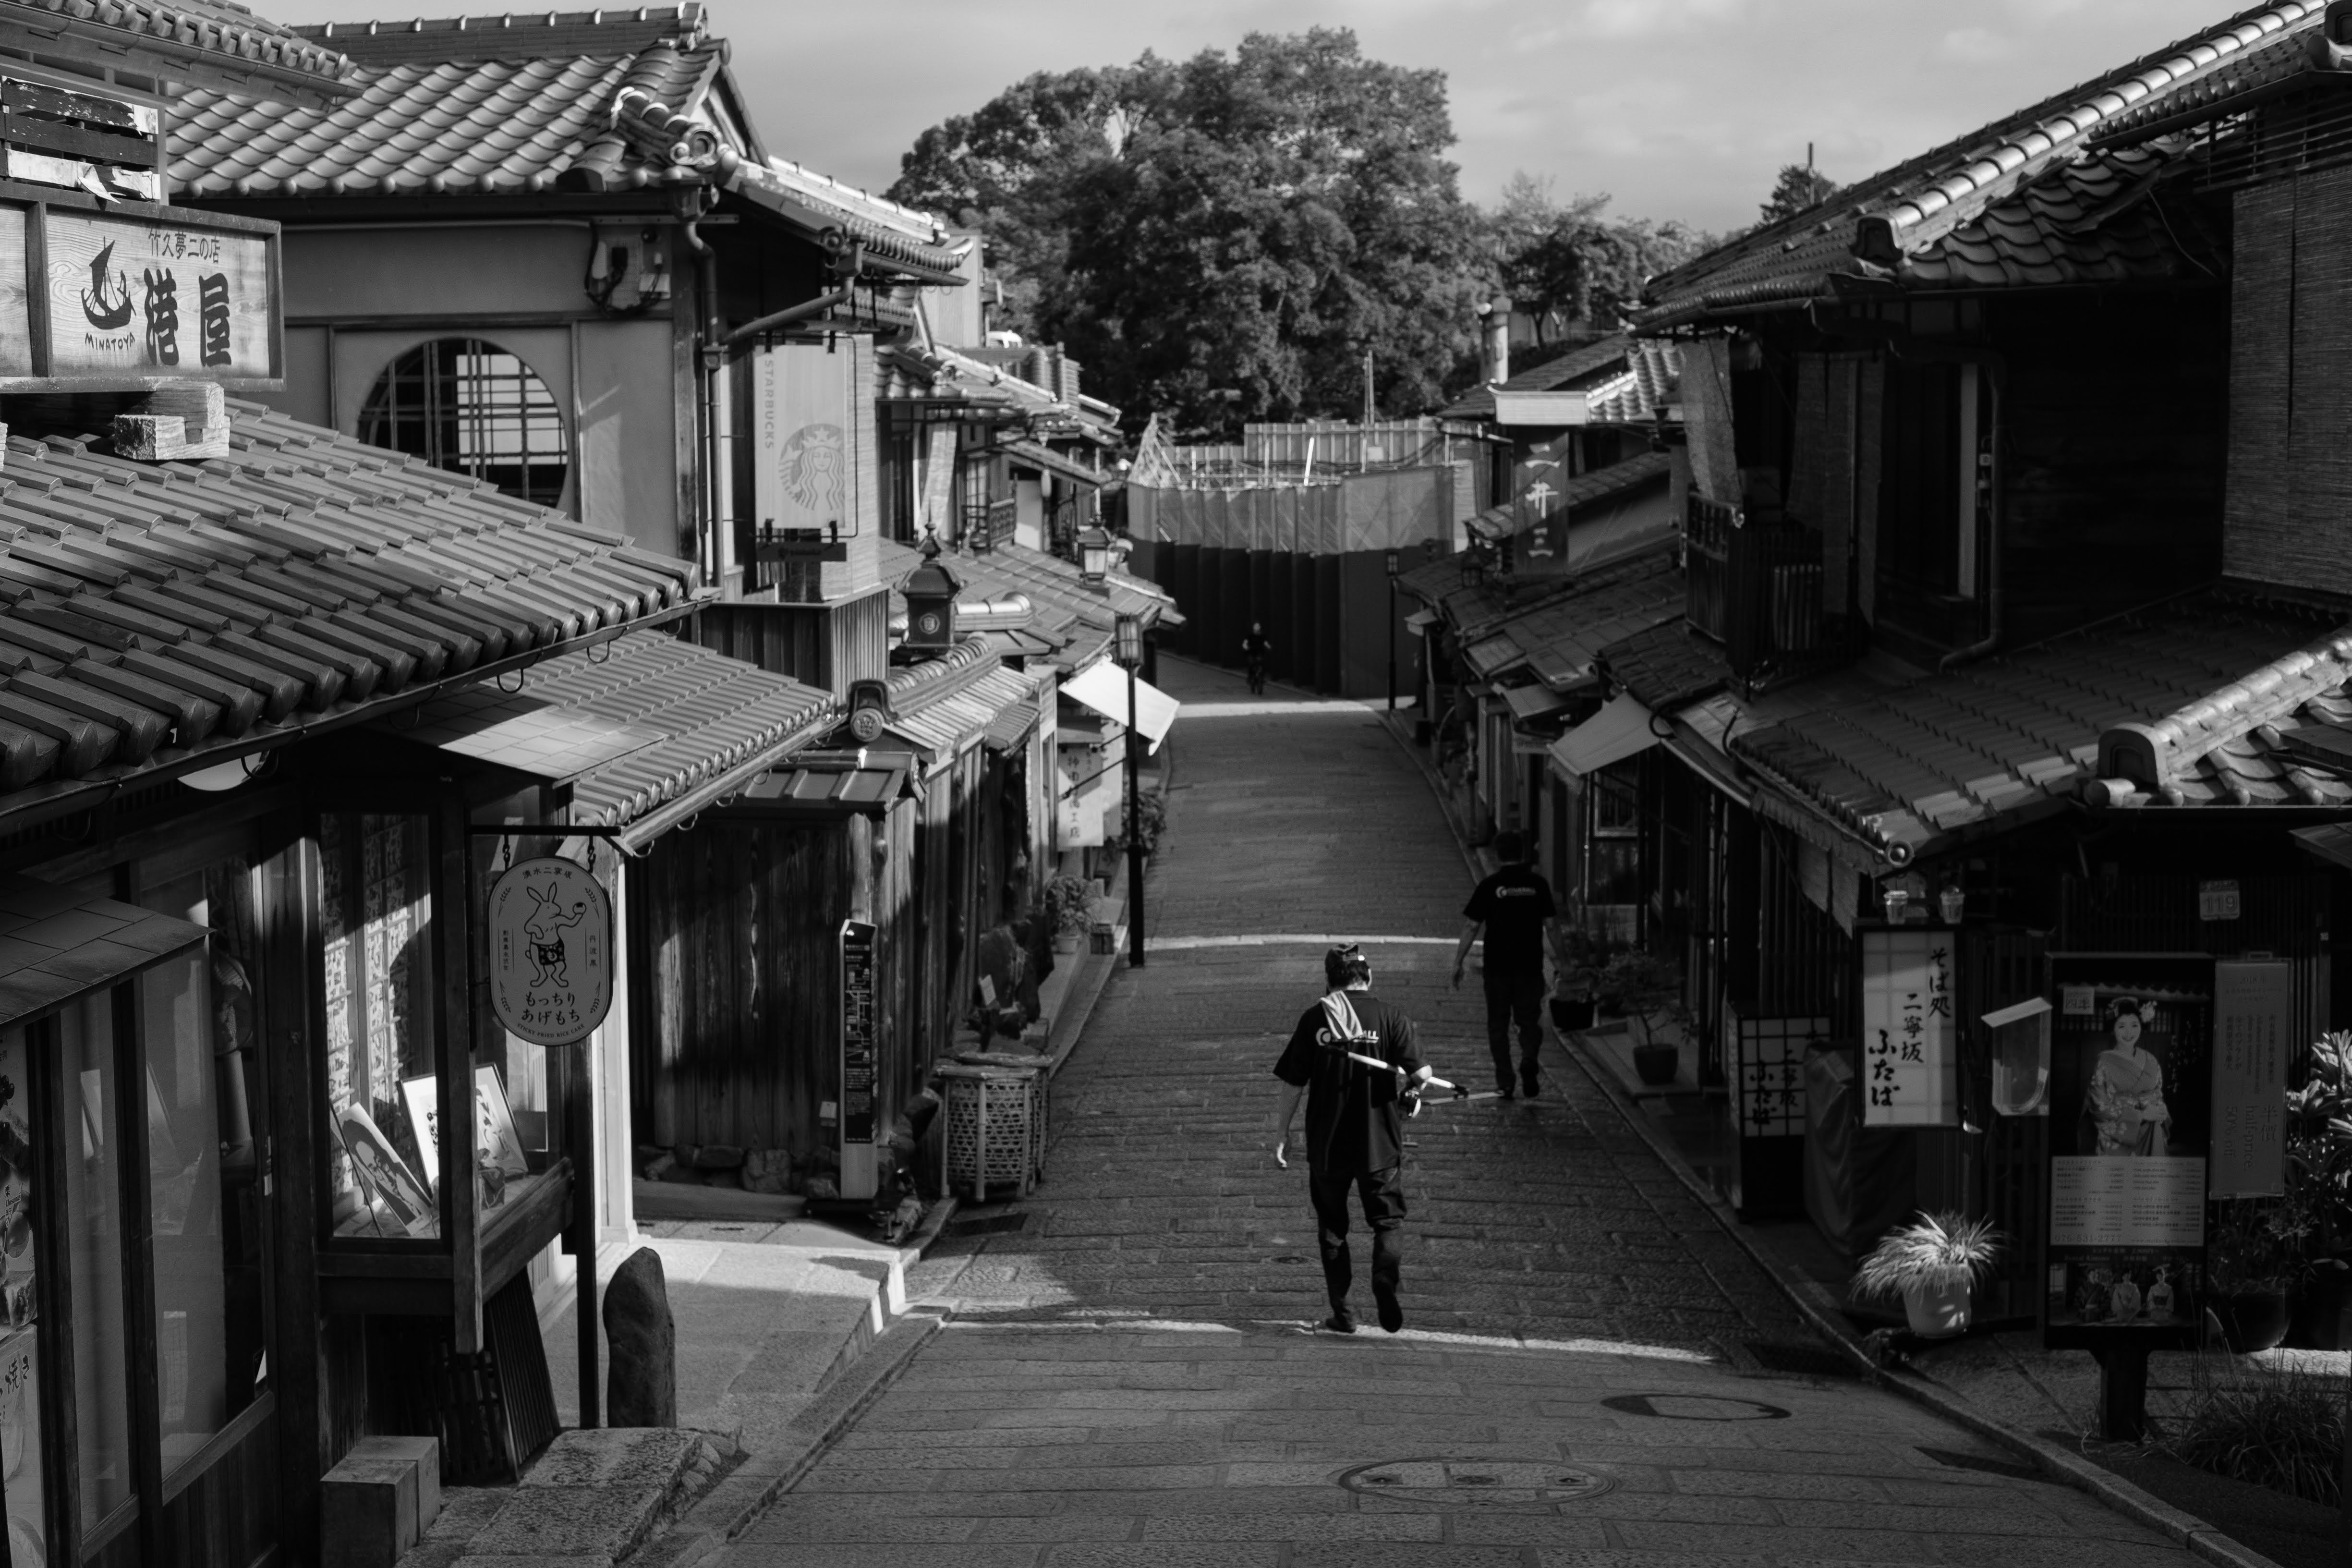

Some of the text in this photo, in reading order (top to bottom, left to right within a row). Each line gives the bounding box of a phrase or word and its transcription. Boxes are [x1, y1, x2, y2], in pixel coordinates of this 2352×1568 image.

[148, 229, 221, 264] 竹久夢二の店
[85, 332, 135, 352] MINATOYA
[144, 268, 232, 367] 港屋
[764, 359, 774, 449] STARBUCKS
[2205, 895, 2236, 912] 119
[526, 991, 575, 1008] もっちり
[1929, 947, 1952, 1018] そば処
[517, 1023, 534, 1035] STICKY
[571, 1024, 584, 1033] CAKE
[521, 1009, 580, 1026] あげもち
[1901, 993, 1924, 1063] 二寧坂
[1868, 1029, 1901, 1106] ふたば
[2243, 1106, 2258, 1172] half-price.
